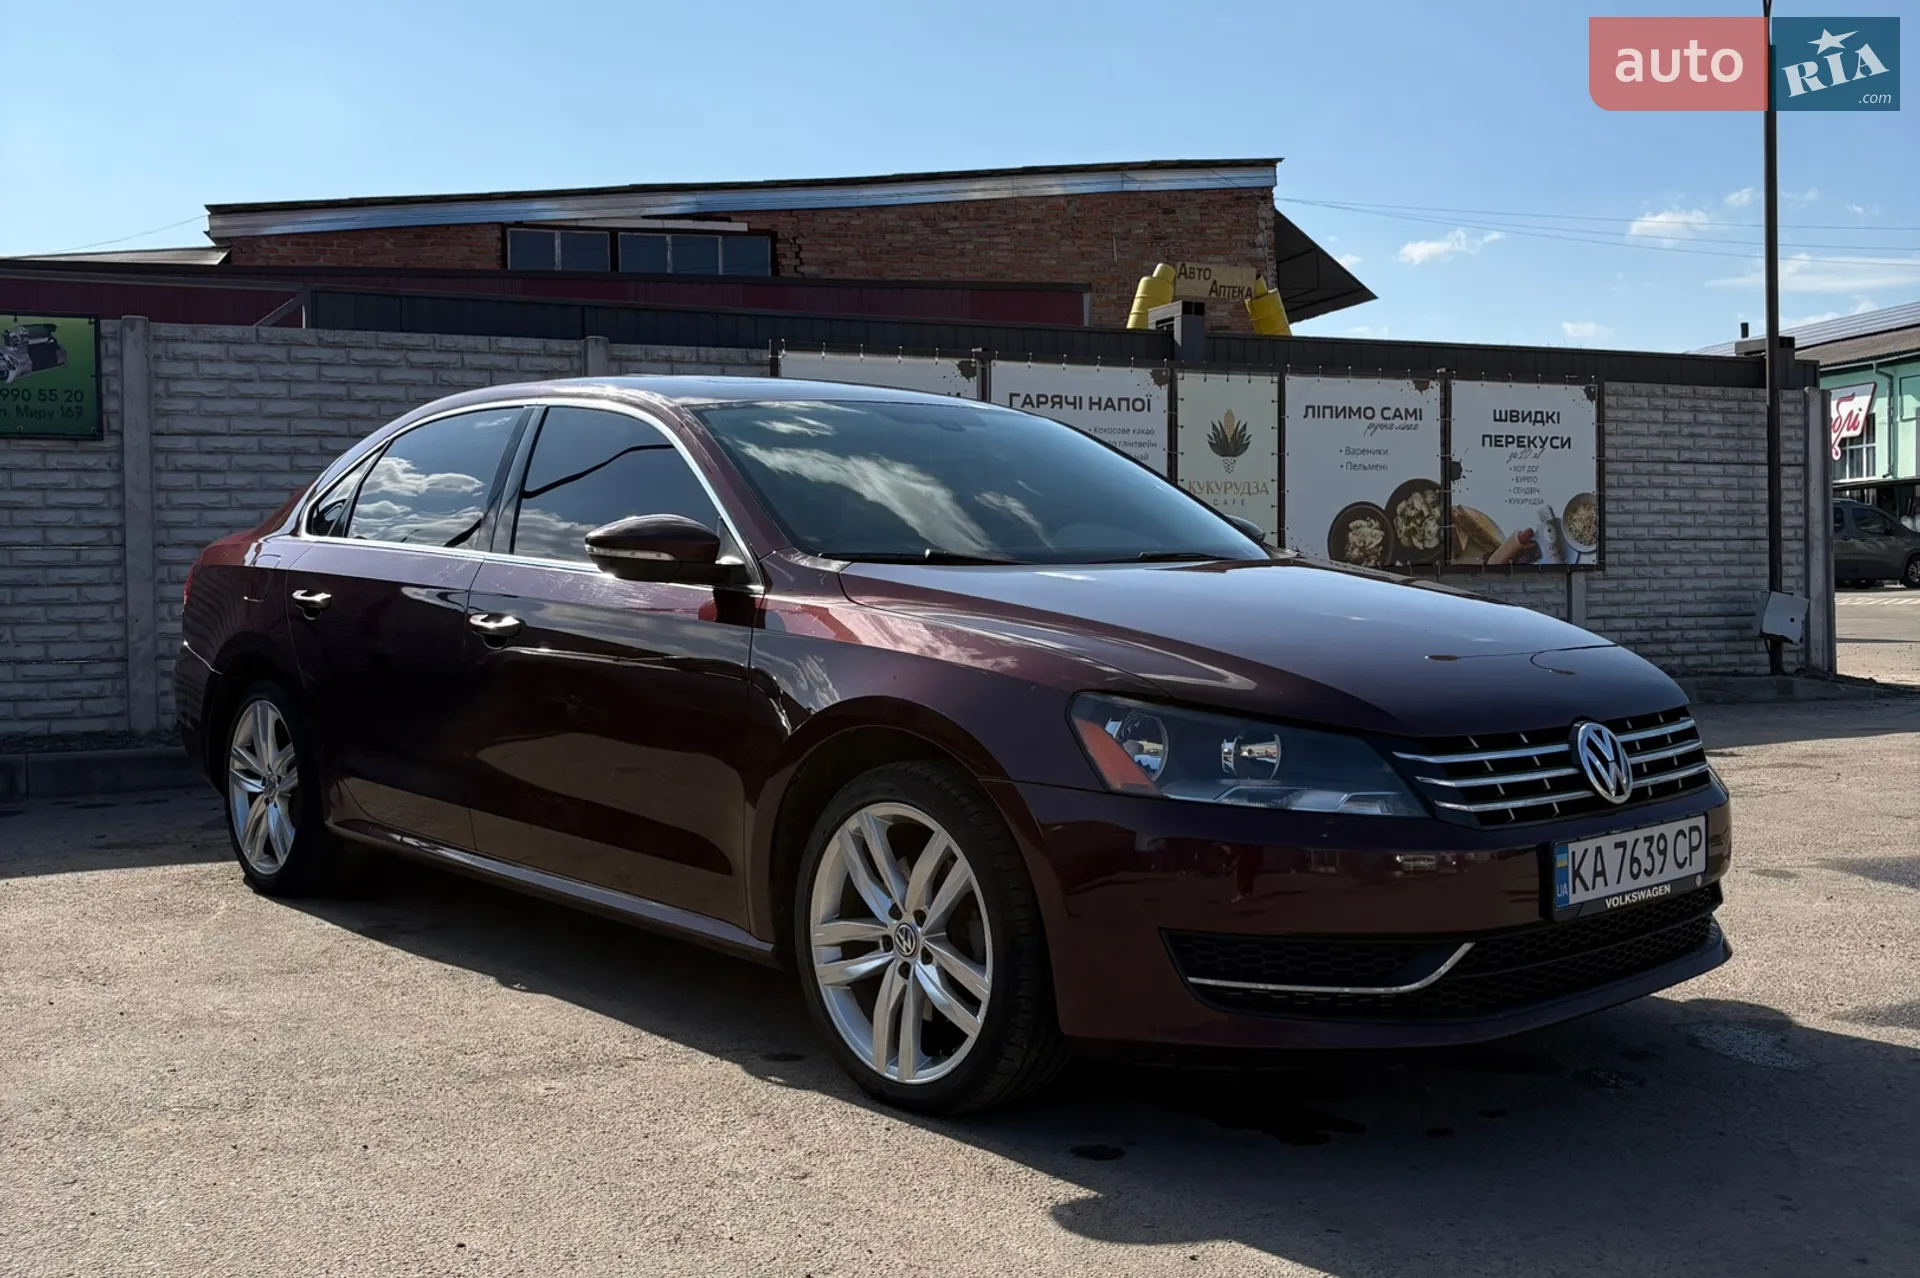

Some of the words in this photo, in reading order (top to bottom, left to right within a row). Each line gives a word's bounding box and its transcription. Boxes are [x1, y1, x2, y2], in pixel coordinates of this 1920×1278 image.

[0, 388, 32, 402] 990
[38, 388, 58, 402] 55
[64, 389, 84, 403] 20
[1008, 392, 1083, 410] ГАРЯЧІ
[1088, 393, 1152, 413] НАПОЇ
[15, 405, 54, 420] Миру
[1303, 404, 1377, 420] ЛІПИМО
[1380, 406, 1423, 421] САМІ
[1492, 408, 1561, 426] ШВИДКІ
[1093, 426, 1131, 435] Кокосове
[1132, 428, 1156, 436] какао
[1118, 440, 1158, 448] глінтвейн
[1481, 434, 1572, 450] ПЕРЕКУСИ
[1344, 446, 1389, 457] Вареники
[1345, 461, 1389, 471] Пельмені
[1188, 480, 1270, 496] КУКУРУДЗА
[1213, 498, 1246, 506] CAFE
[1614, 832, 1668, 885] 7639
[1556, 884, 1569, 897] UA
[1605, 885, 1671, 908] VOLKSWAGEN
